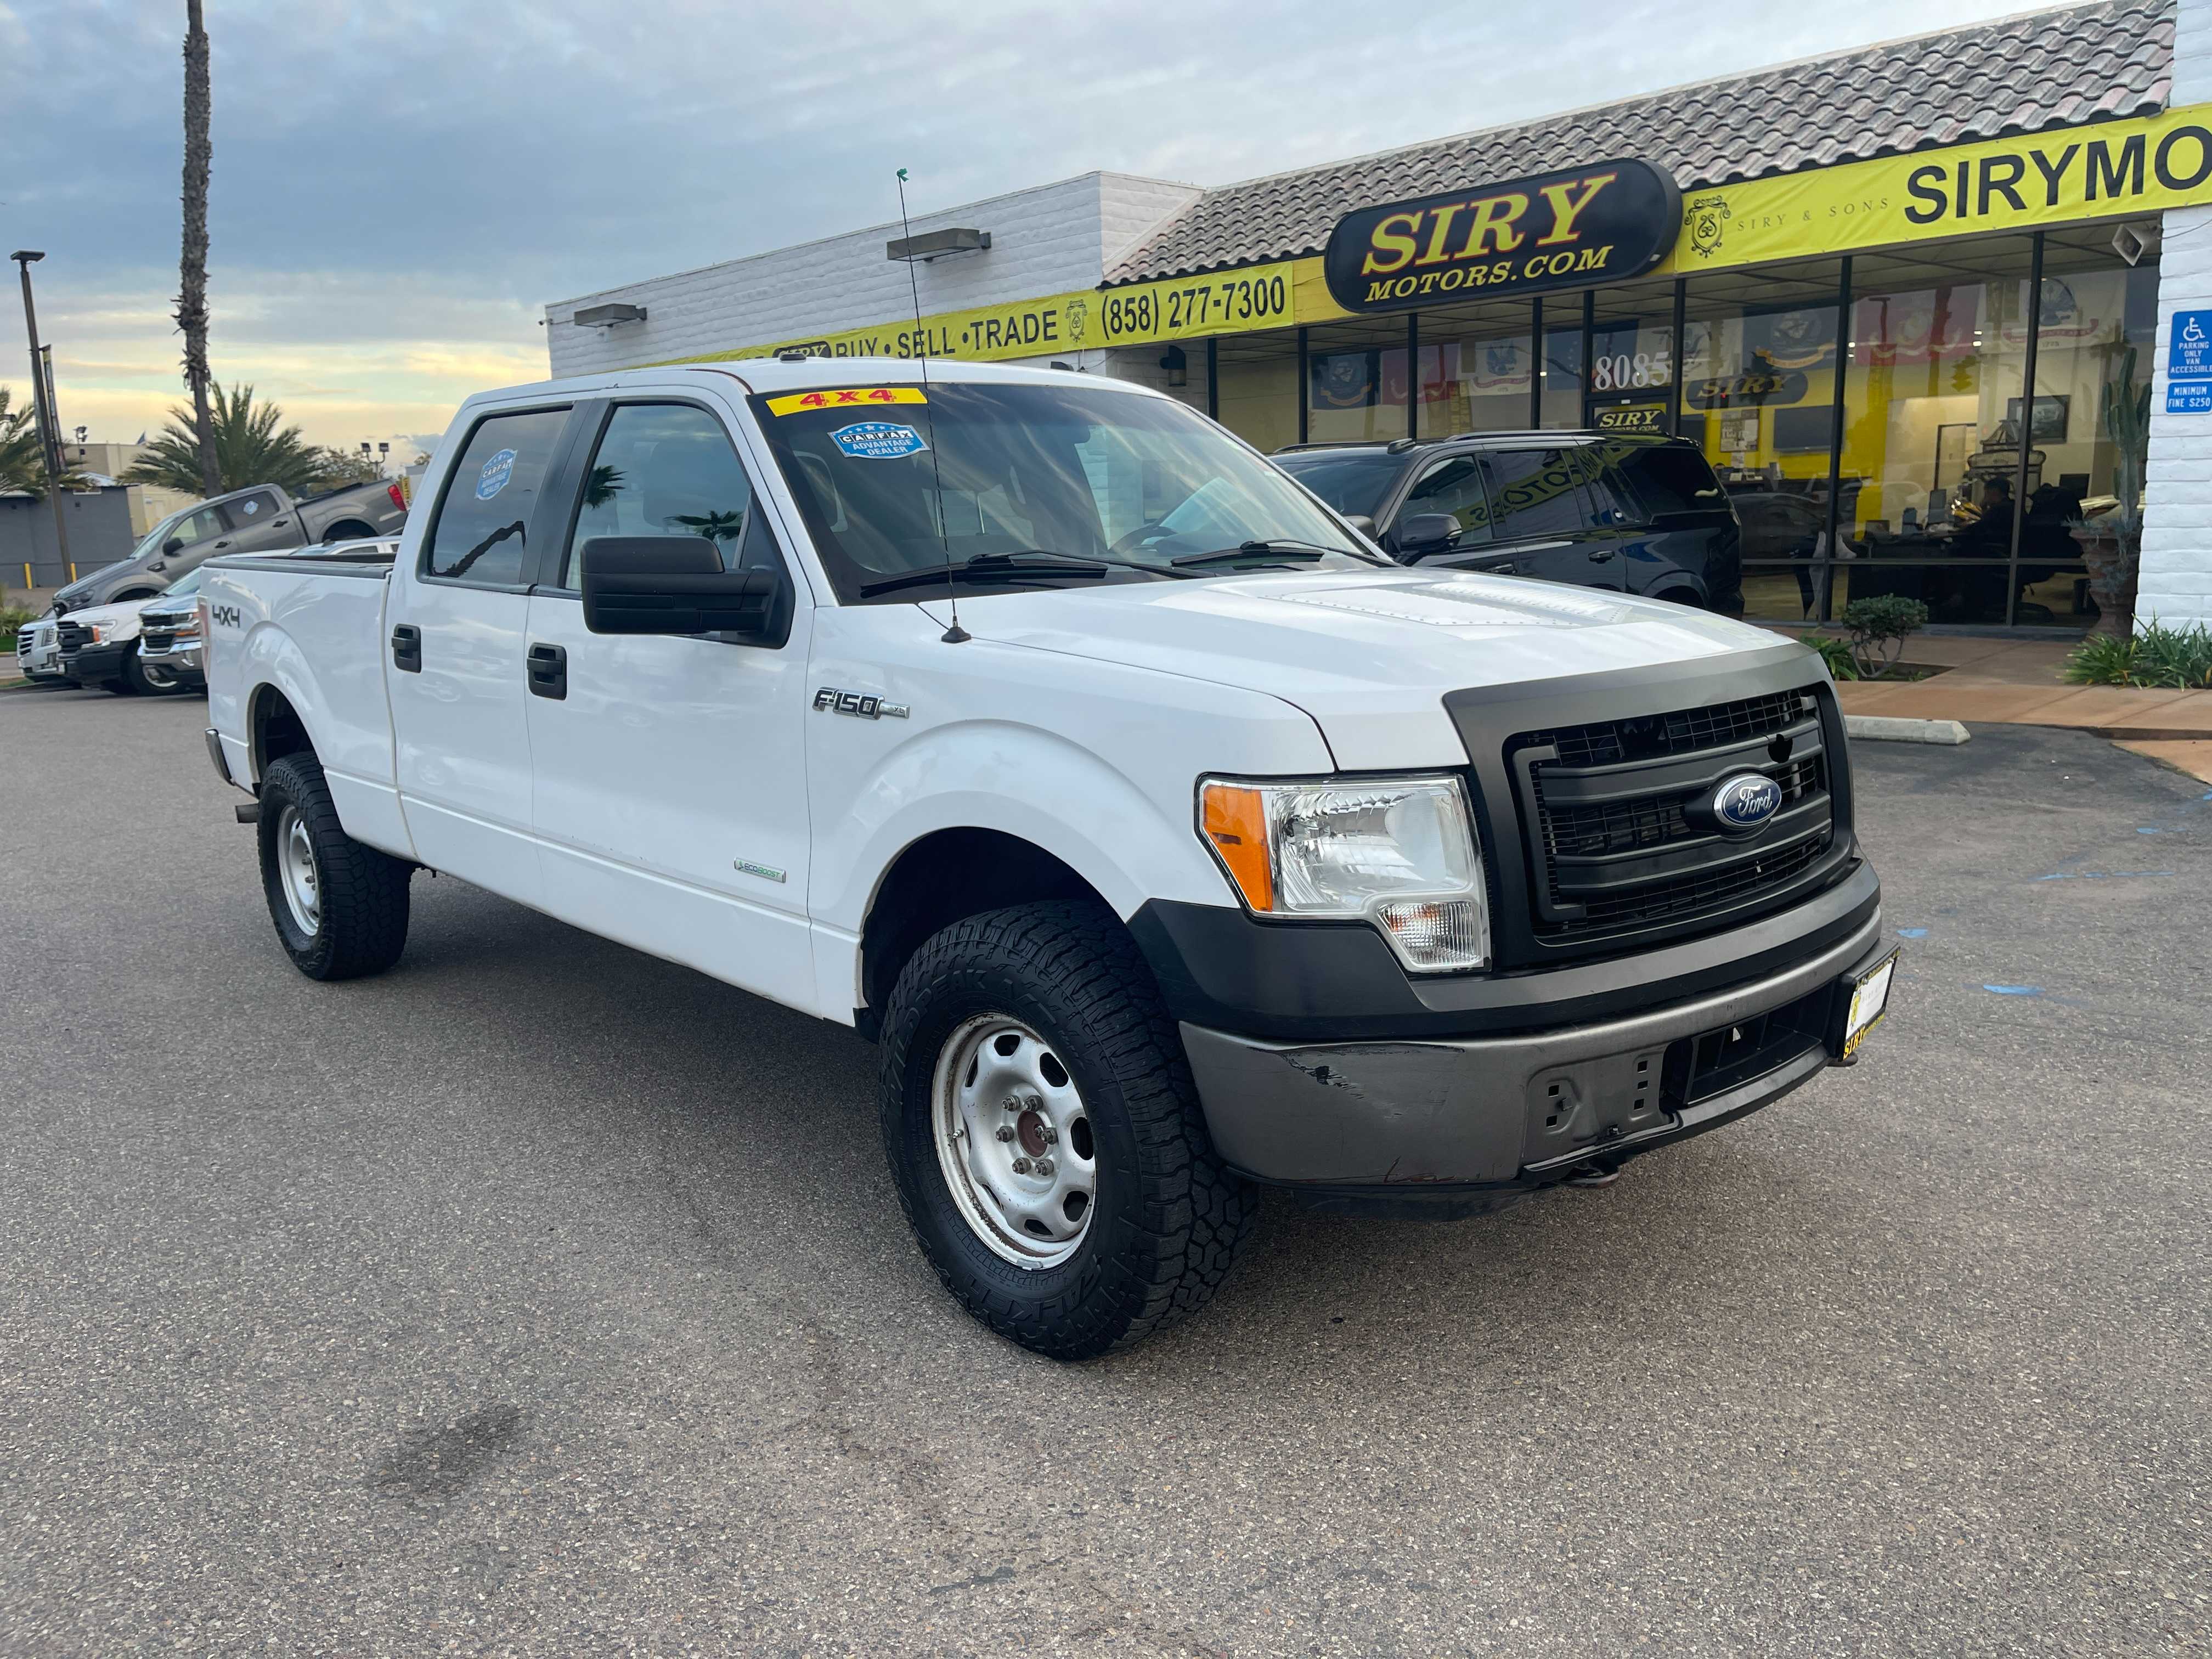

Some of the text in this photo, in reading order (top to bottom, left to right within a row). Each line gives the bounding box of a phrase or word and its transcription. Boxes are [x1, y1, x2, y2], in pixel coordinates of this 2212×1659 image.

[1904, 126, 2212, 224] SIRYMO
[1361, 172, 1618, 275] SIRY
[1738, 198, 1888, 232] SIRY & SONS
[1364, 245, 1613, 302] MOTORS.COM
[1102, 275, 1285, 340] (858) 277-7300
[836, 337, 878, 357] BUY
[898, 326, 956, 359] SELL
[969, 309, 1059, 351] TRADE
[2178, 342, 2210, 350] PARKING
[1594, 351, 1669, 391] 8085
[2170, 365, 2212, 374] ACCESSIBLE
[1697, 374, 1793, 398] SIRY
[2174, 386, 2208, 396] MINIMUM
[2168, 398, 2185, 408] FINE
[1599, 410, 1661, 428] SIRY
[839, 430, 915, 444] CARFAX
[853, 439, 913, 450] ADVANTAGE
[866, 447, 909, 456] DEALER
[212, 604, 240, 629] 4X4
[813, 687, 882, 719] F-150
[1737, 785, 1773, 817] Ford
[1843, 1025, 1866, 1061] SIRY
